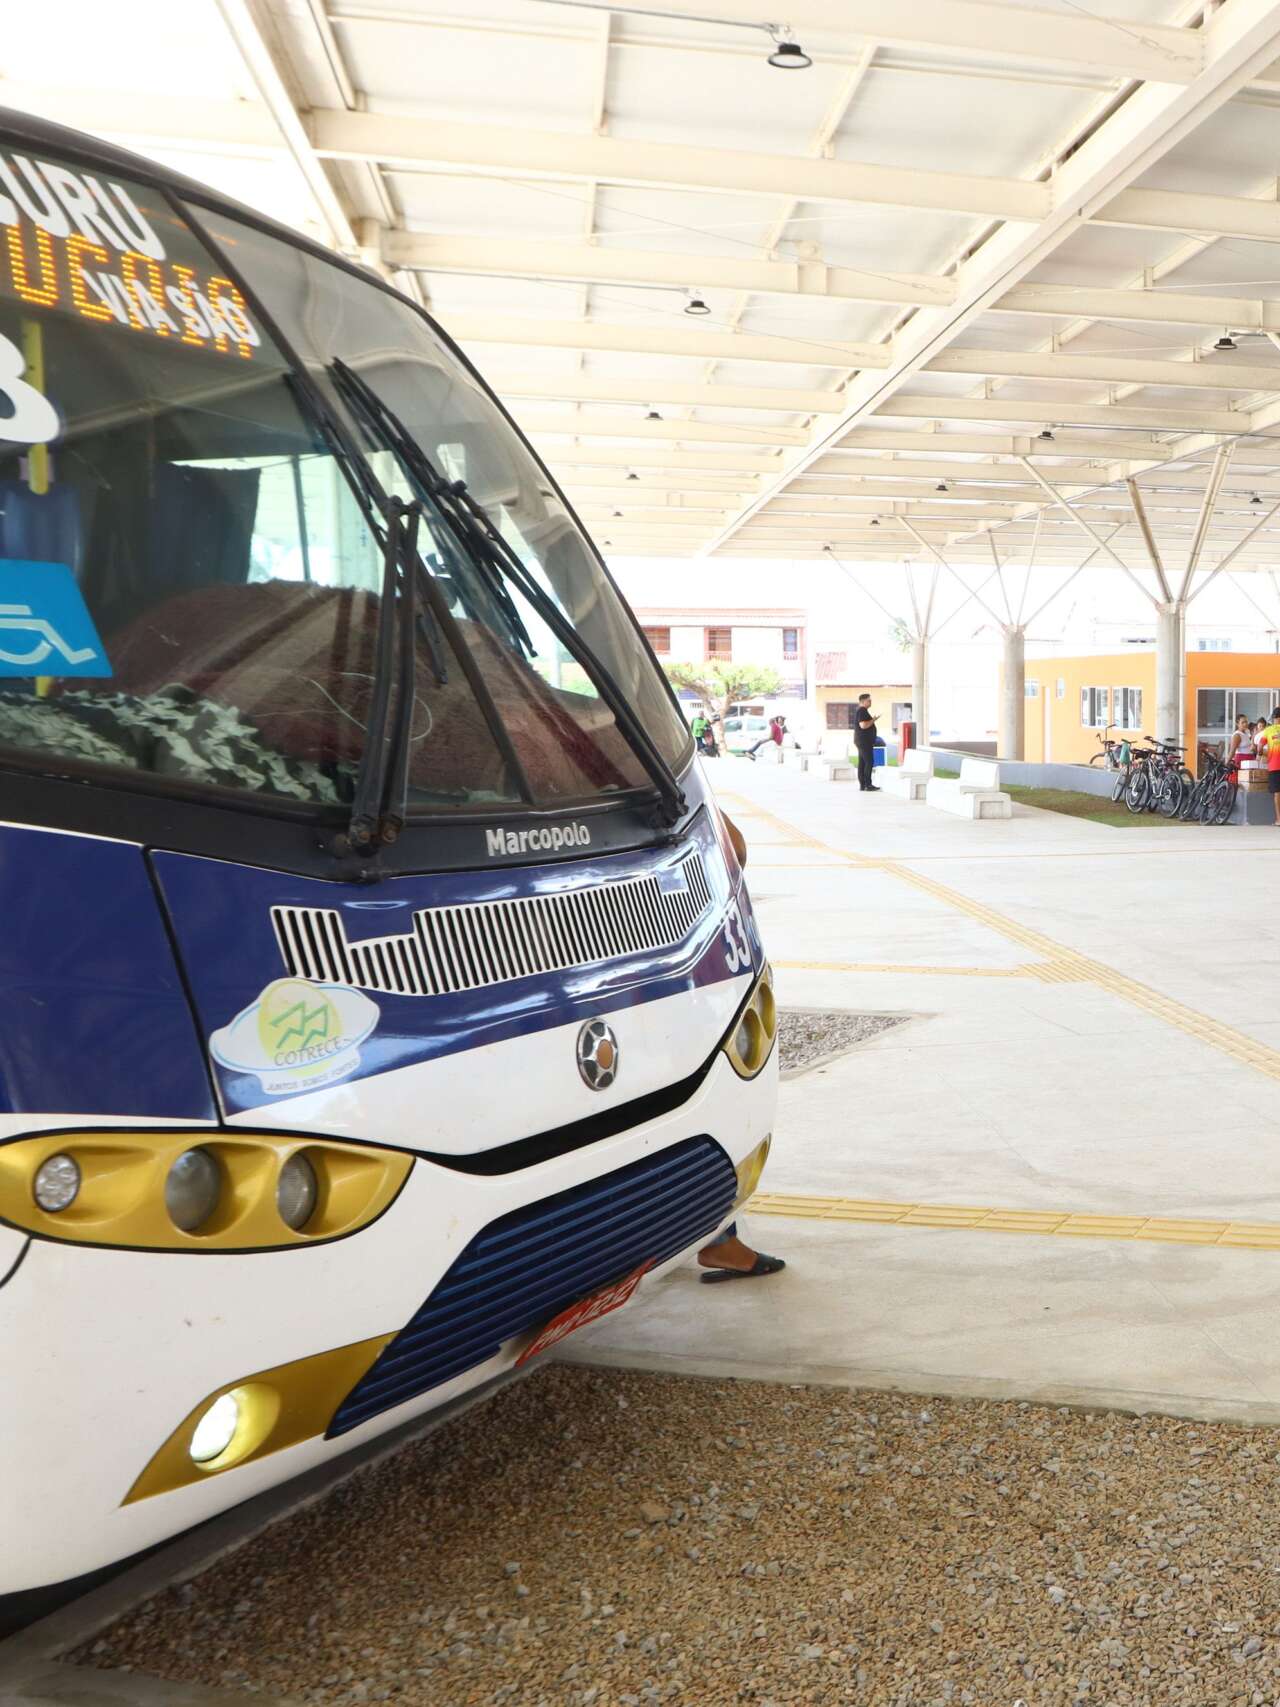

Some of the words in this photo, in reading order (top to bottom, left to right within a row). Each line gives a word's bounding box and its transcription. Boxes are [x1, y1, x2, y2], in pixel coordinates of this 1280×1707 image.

[0, 153, 166, 261] URU
[80, 268, 180, 333] VIA
[485, 822, 591, 857] Marcopolo
